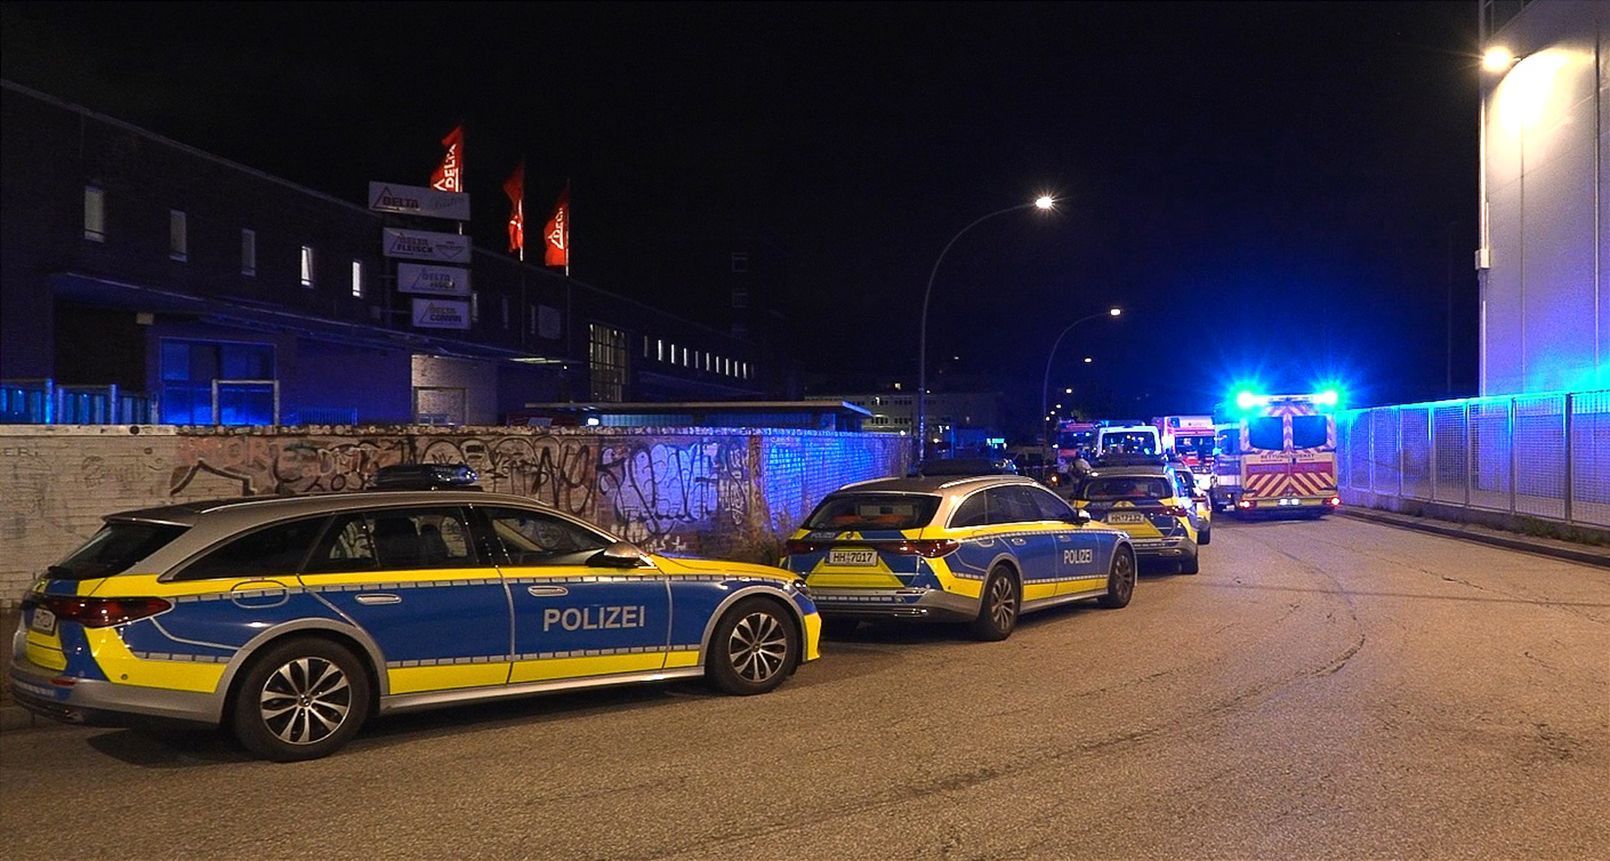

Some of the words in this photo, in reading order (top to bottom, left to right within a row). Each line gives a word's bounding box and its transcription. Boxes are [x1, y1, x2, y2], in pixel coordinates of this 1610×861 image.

[383, 196, 419, 209] DELTA
[833, 553, 845, 563] HH
[850, 553, 874, 562] 7017
[1063, 549, 1093, 564] POLIZEI
[543, 606, 645, 632] POLIZEI
